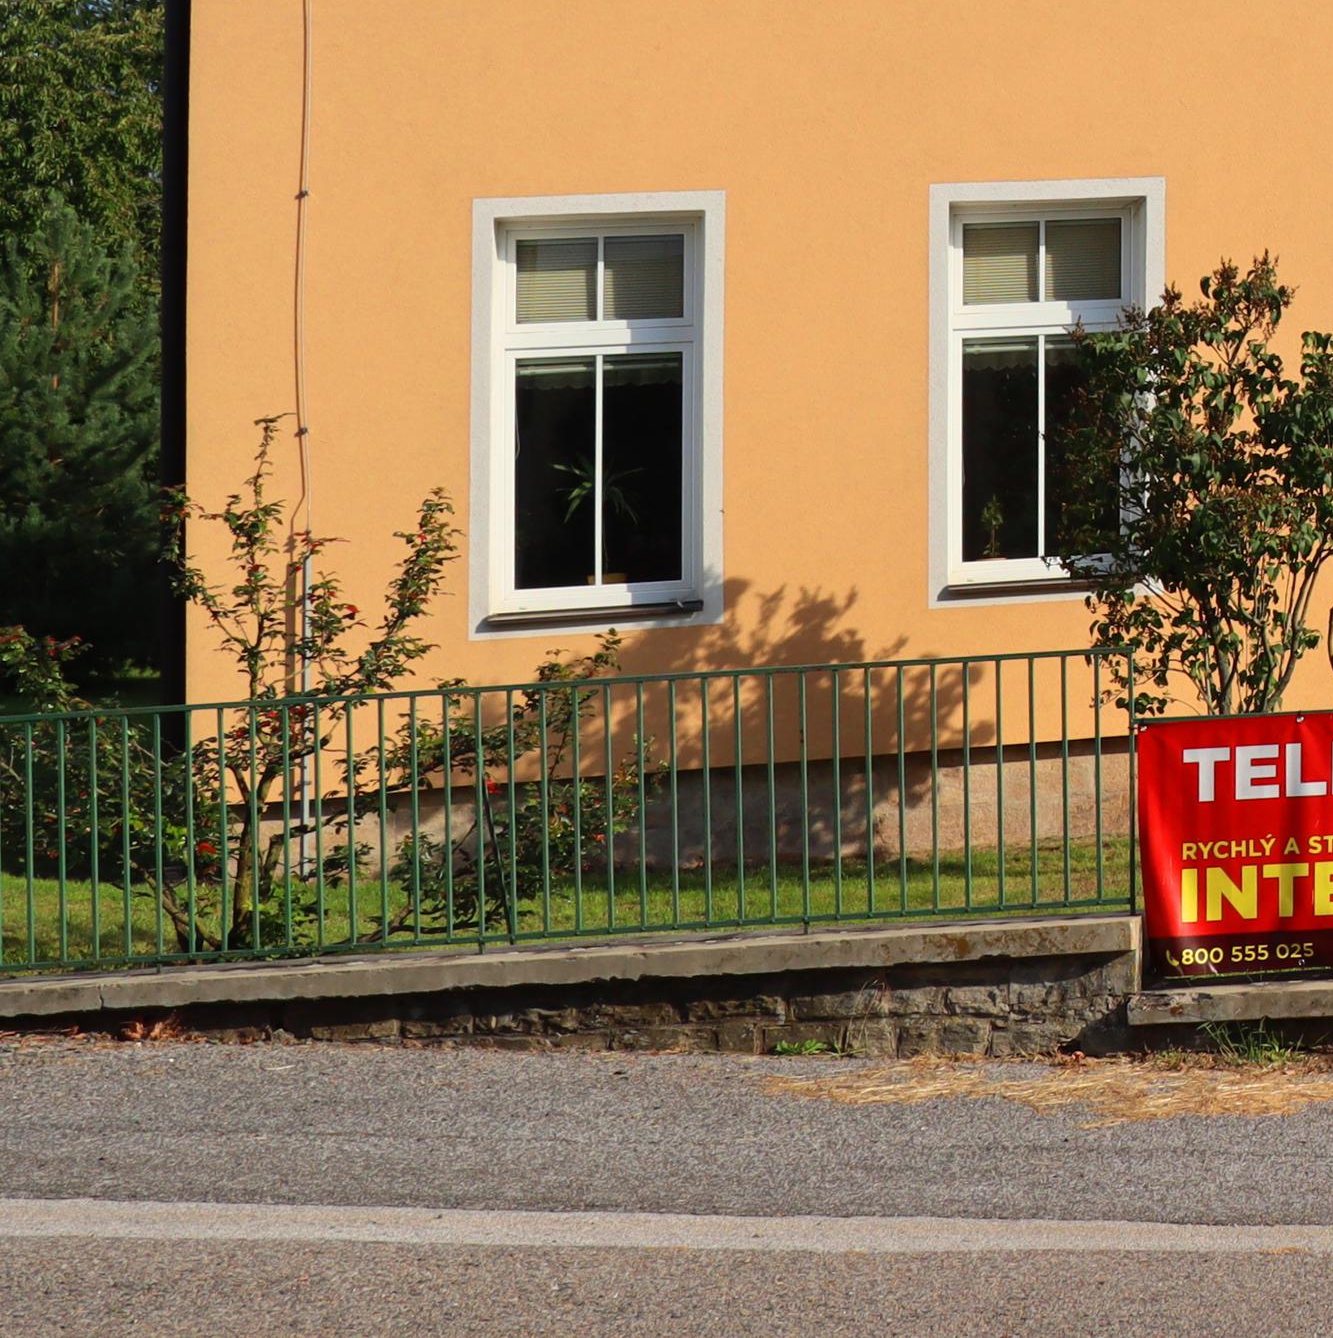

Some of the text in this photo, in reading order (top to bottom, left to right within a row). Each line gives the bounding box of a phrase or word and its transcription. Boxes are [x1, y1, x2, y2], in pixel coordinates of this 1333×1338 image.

[1182, 834, 1277, 861] RYCHLÝ
[1284, 836, 1300, 855] A
[1181, 942, 1315, 965] 800 555 025
